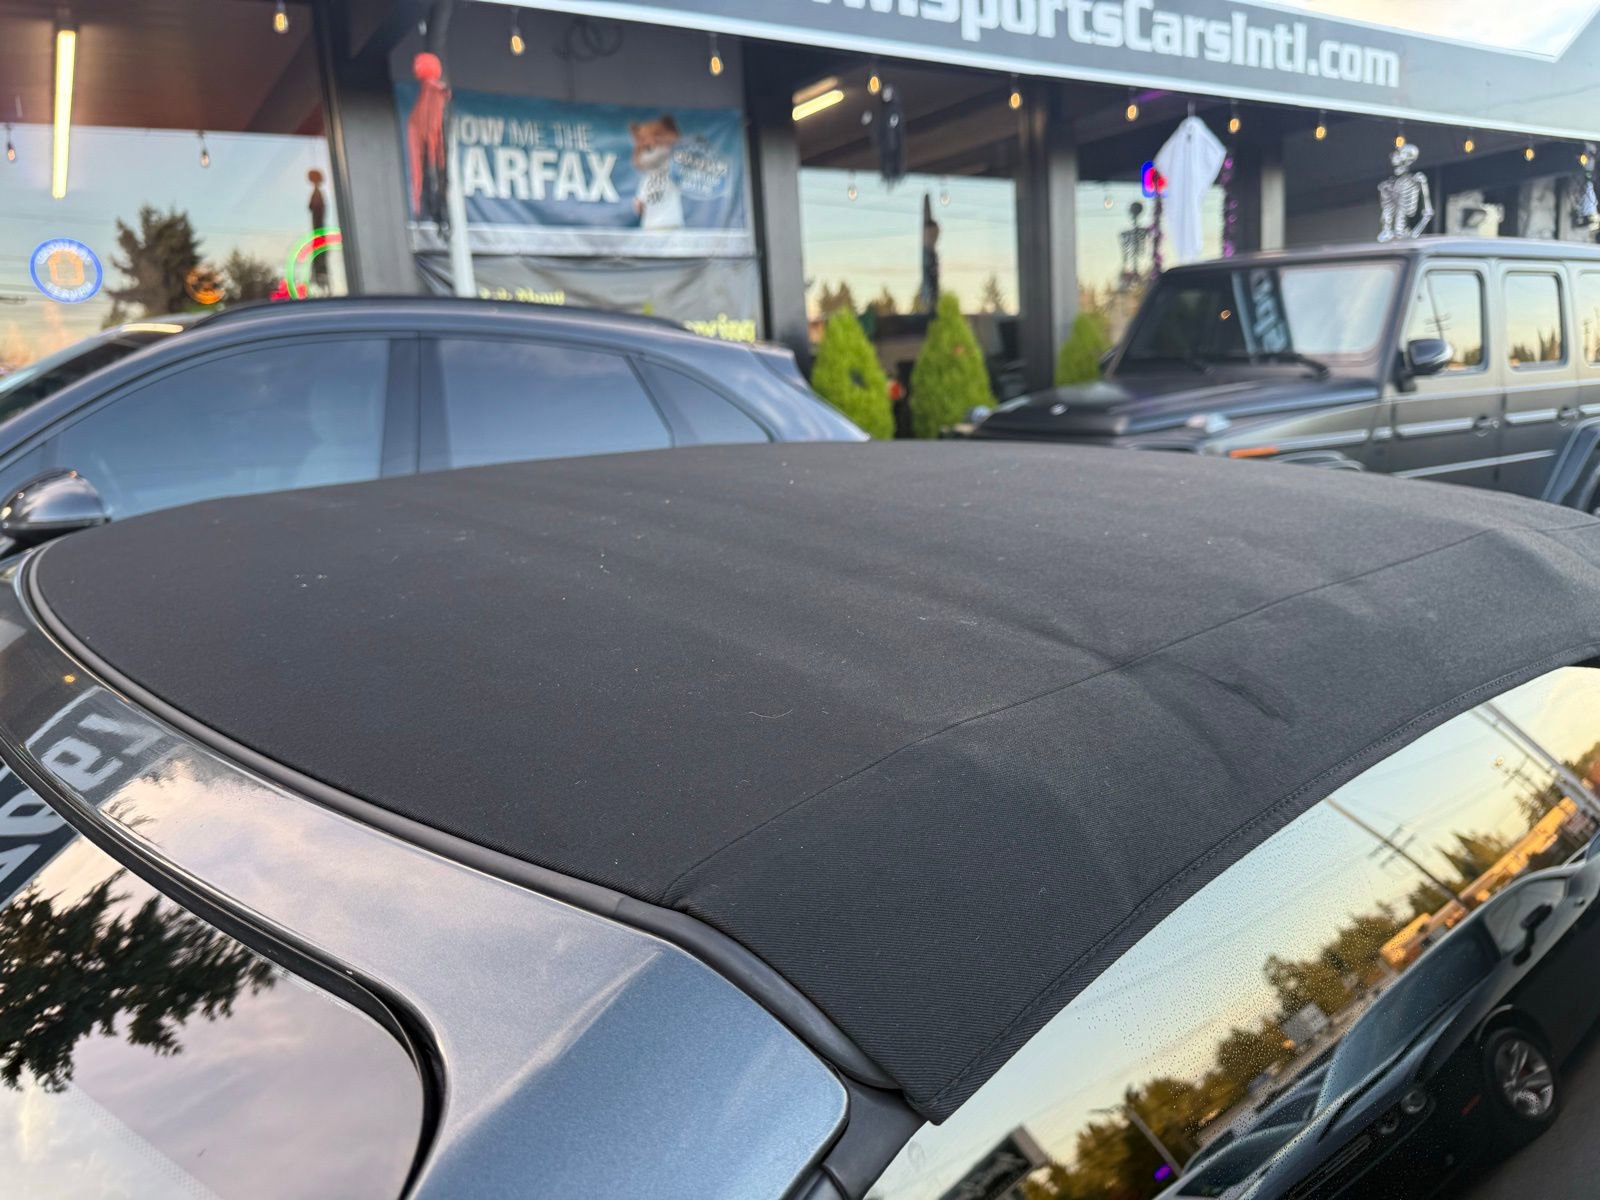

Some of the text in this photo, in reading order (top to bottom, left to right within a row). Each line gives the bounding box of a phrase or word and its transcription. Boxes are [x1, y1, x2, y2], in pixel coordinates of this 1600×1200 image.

[454, 113, 592, 153] OW ME THE
[462, 147, 620, 203] ARFAX
